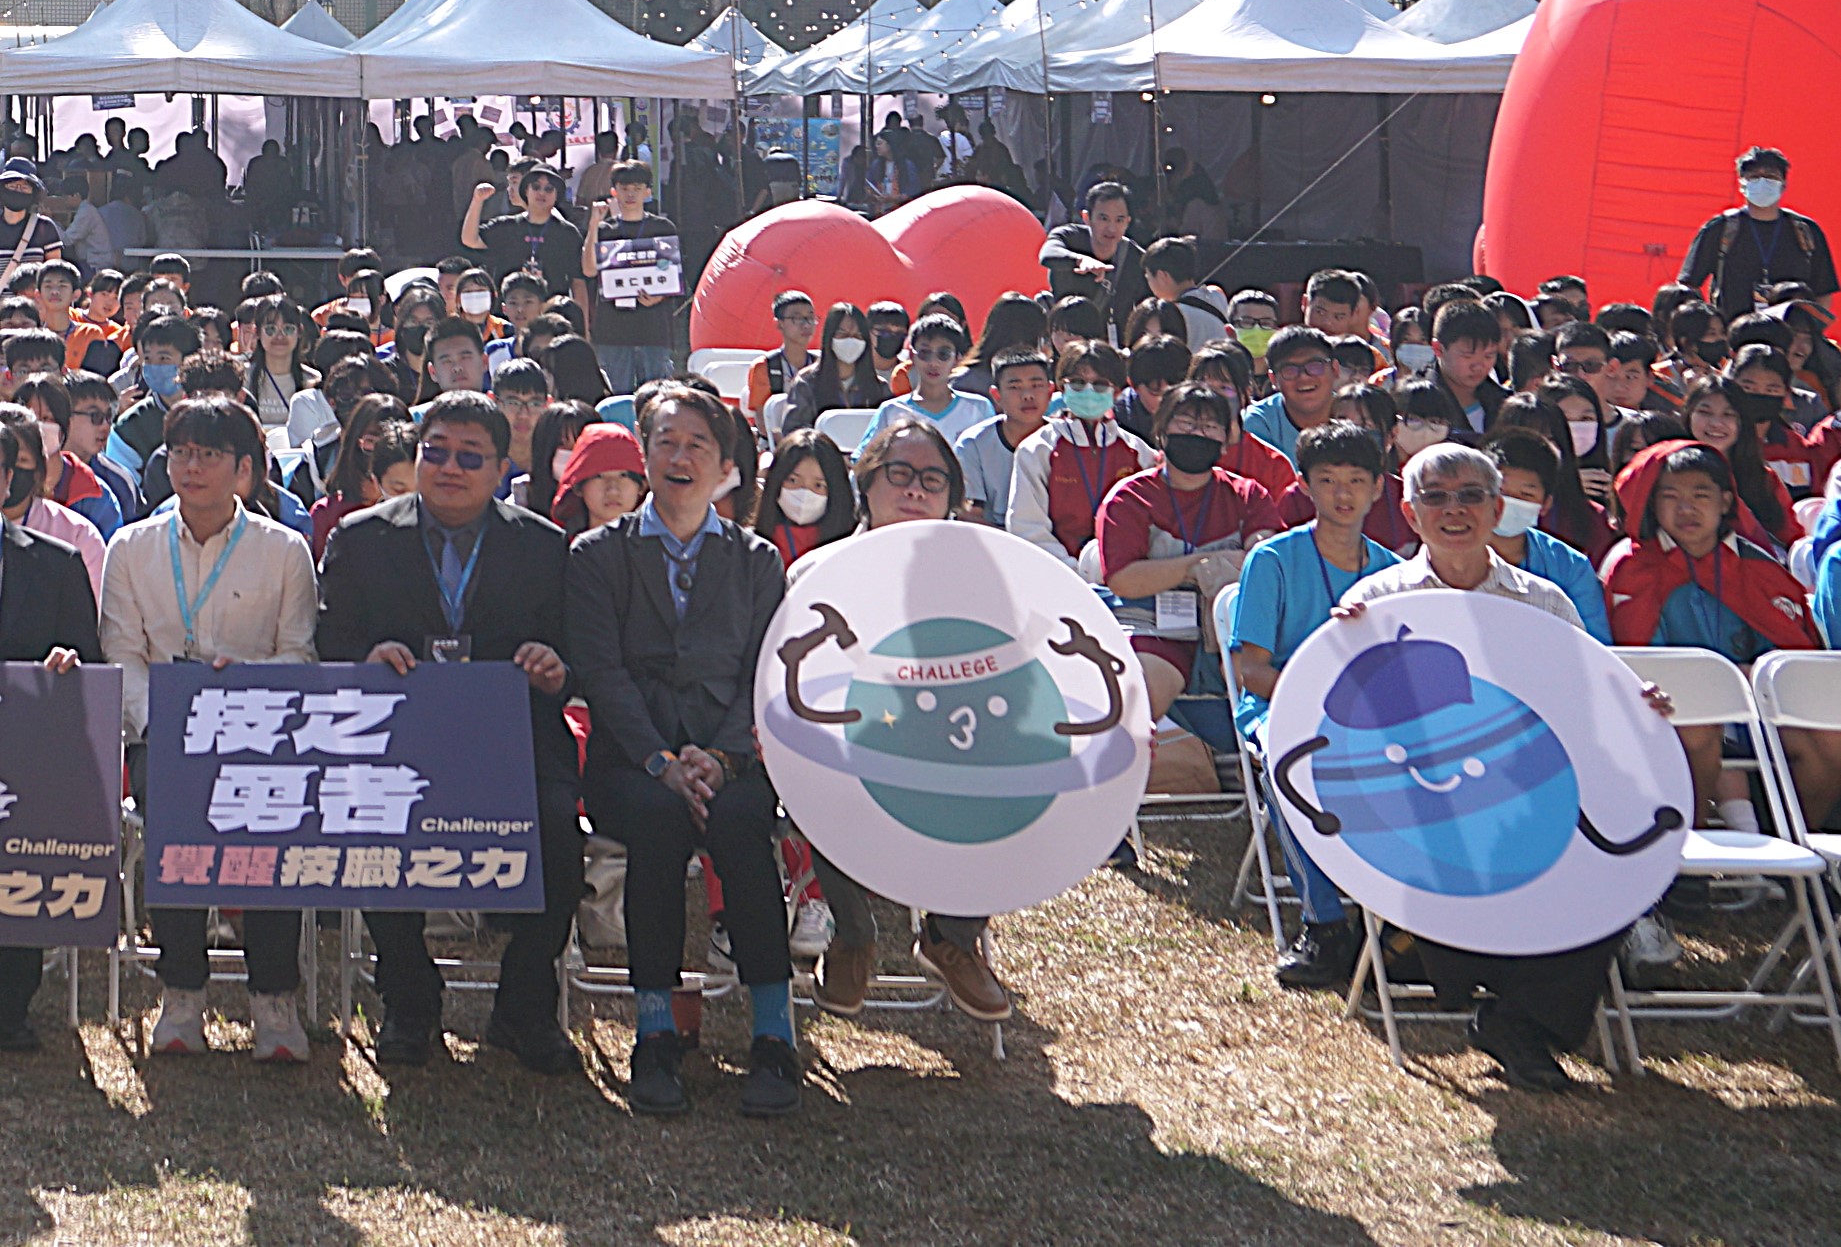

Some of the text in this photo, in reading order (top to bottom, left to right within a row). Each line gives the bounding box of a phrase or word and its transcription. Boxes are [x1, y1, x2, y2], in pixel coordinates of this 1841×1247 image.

[897, 655, 999, 681] CHALLEGE
[183, 687, 407, 755] 技之
[207, 763, 431, 834] 勇者
[421, 817, 534, 837] Challenger
[5, 837, 115, 861] Challenger
[157, 844, 528, 889] 覺醒技職之力
